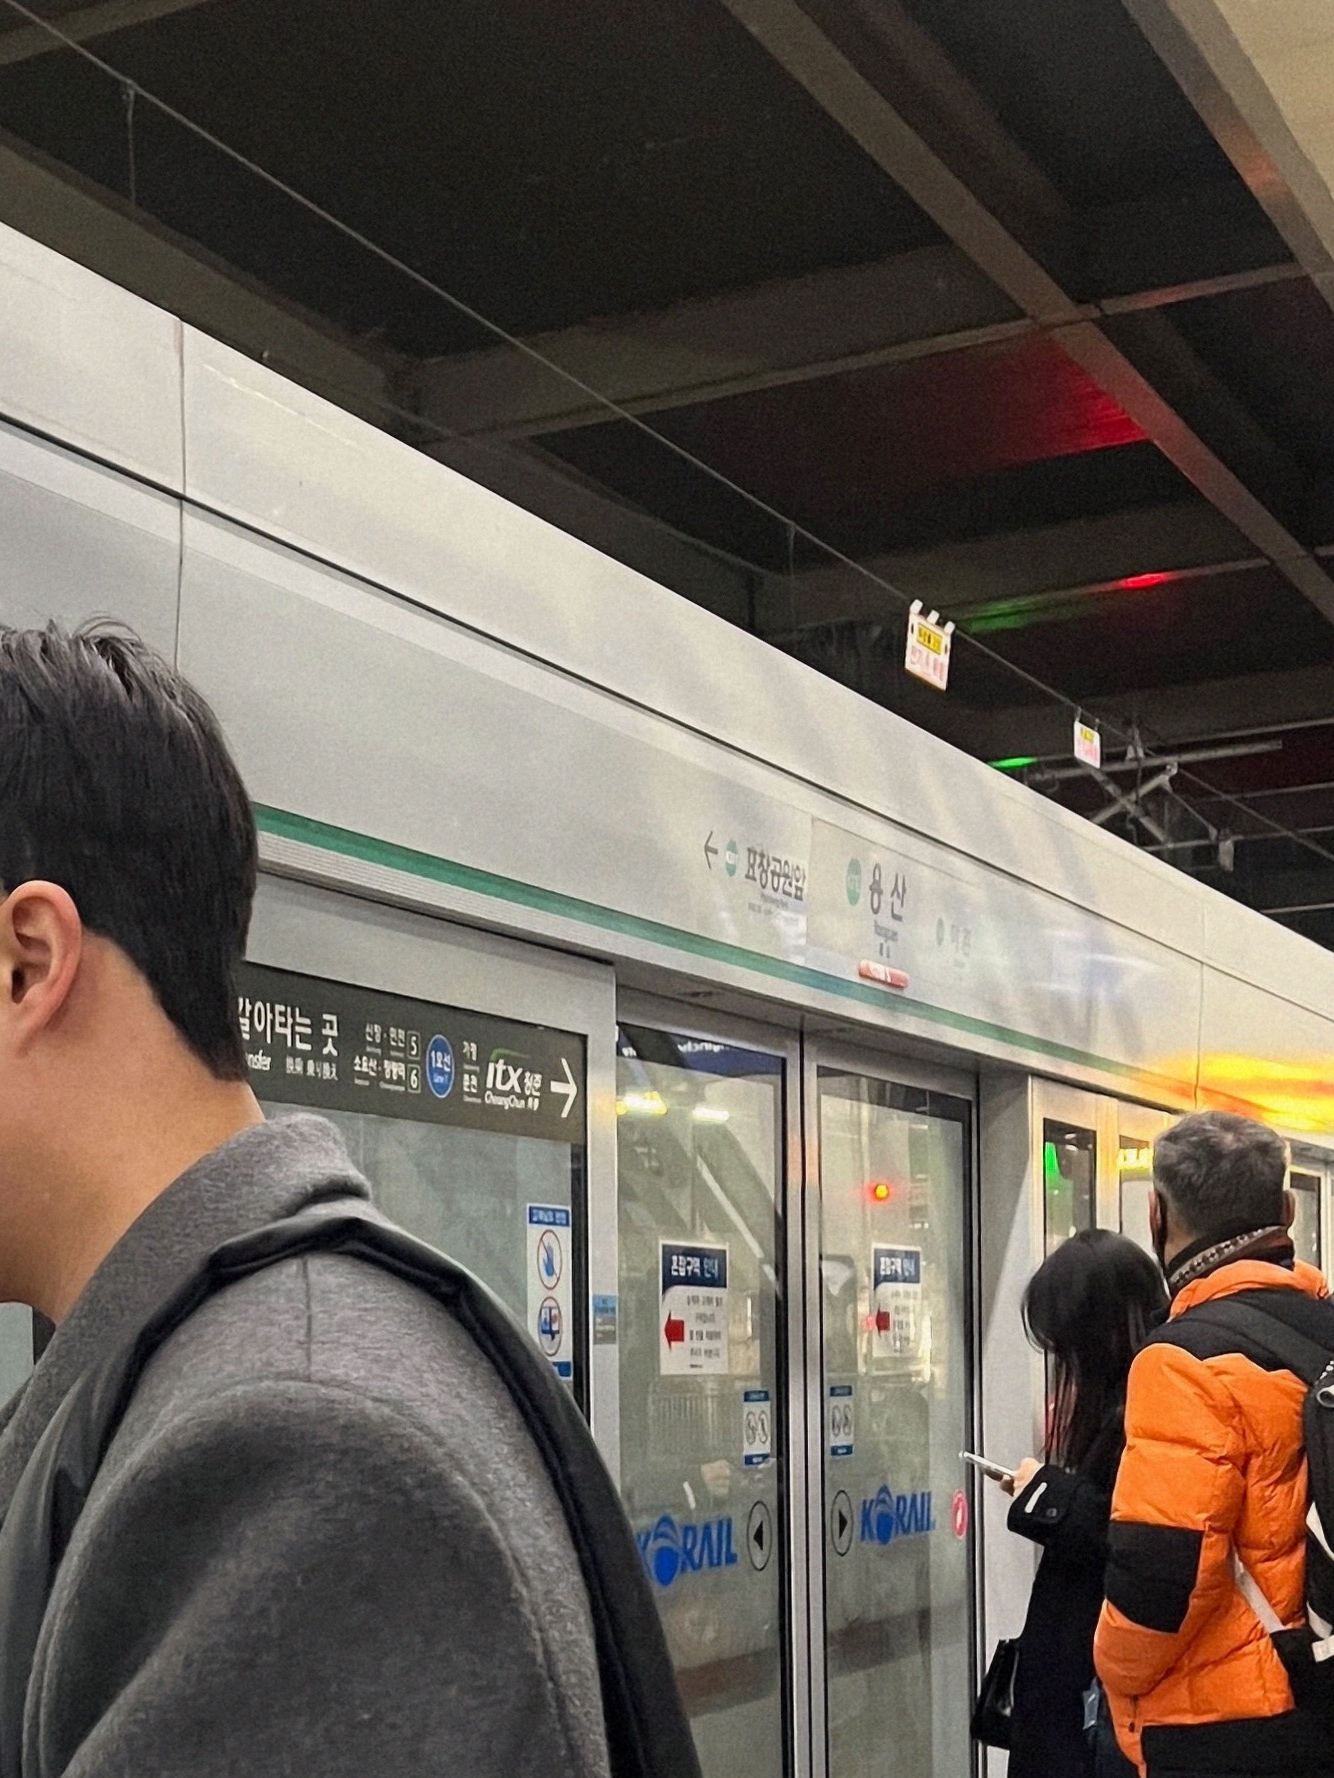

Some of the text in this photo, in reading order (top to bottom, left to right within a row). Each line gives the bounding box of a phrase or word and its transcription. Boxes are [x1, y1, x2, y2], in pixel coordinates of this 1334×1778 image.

[322, 1013, 339, 1057] 곳
[409, 1035, 418, 1056] 5
[430, 1050, 451, 1073] 1호선
[409, 1068, 419, 1089] 6
[860, 1484, 933, 1546] KORAIL
